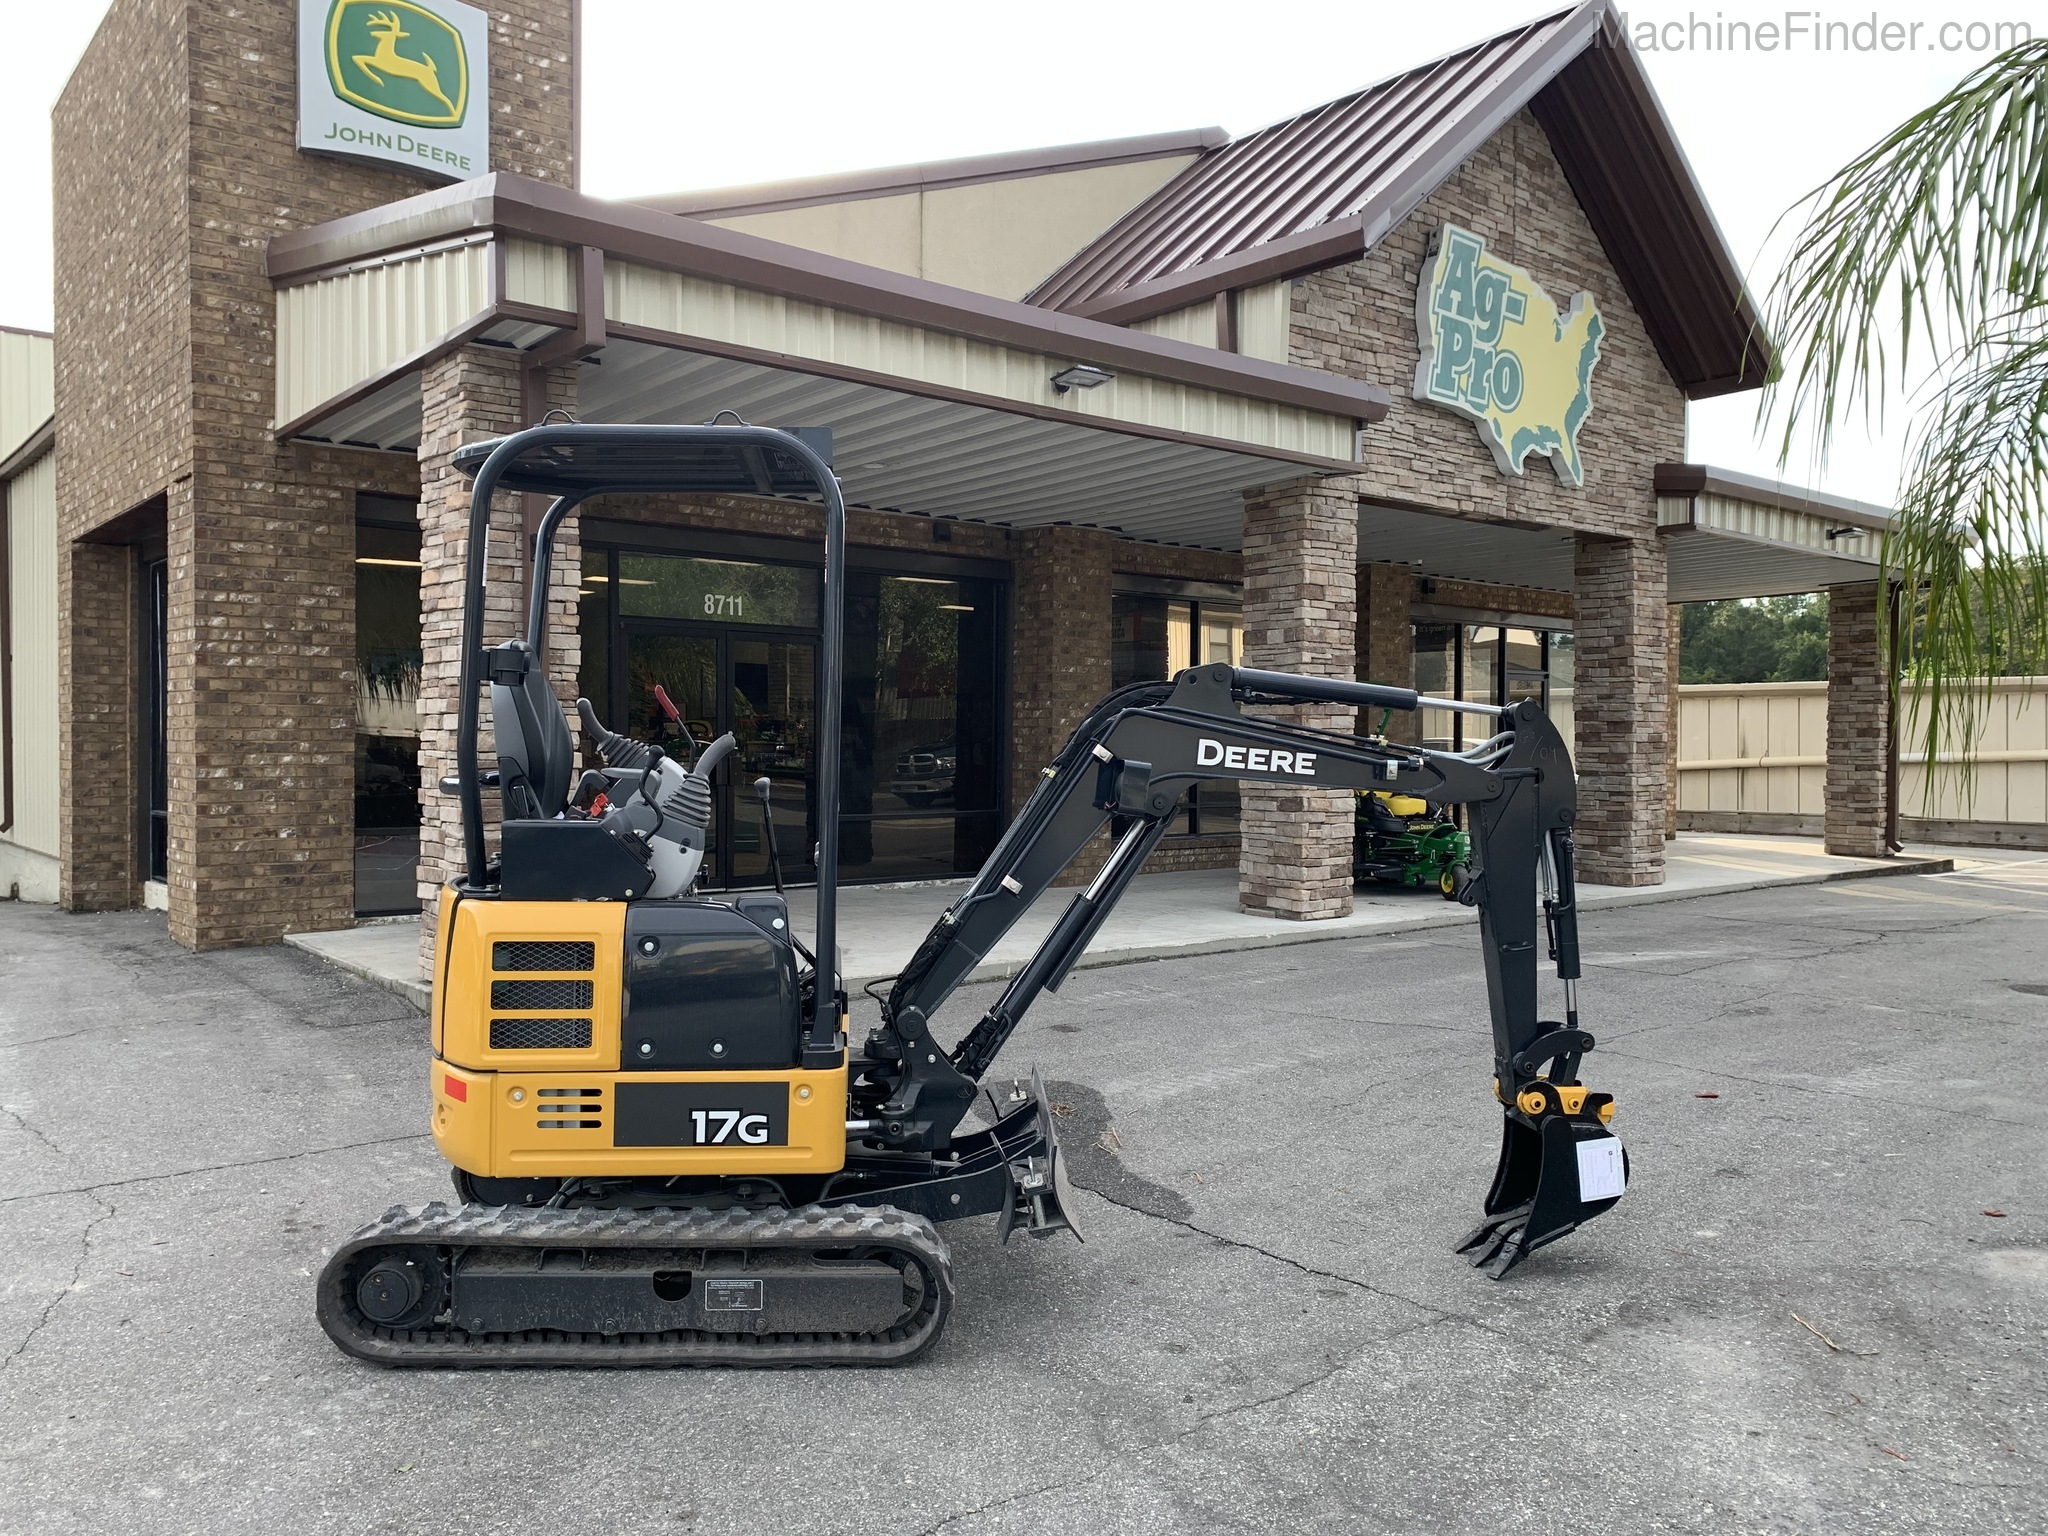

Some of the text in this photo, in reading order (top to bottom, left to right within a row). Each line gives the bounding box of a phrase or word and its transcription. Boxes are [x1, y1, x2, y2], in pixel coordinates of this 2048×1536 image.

[324, 122, 471, 171] JOHN DEERE
[1431, 313, 1522, 411] Pro
[704, 593, 743, 616] 8711
[1197, 738, 1317, 775] DEERE
[691, 1110, 768, 1144] 17G
